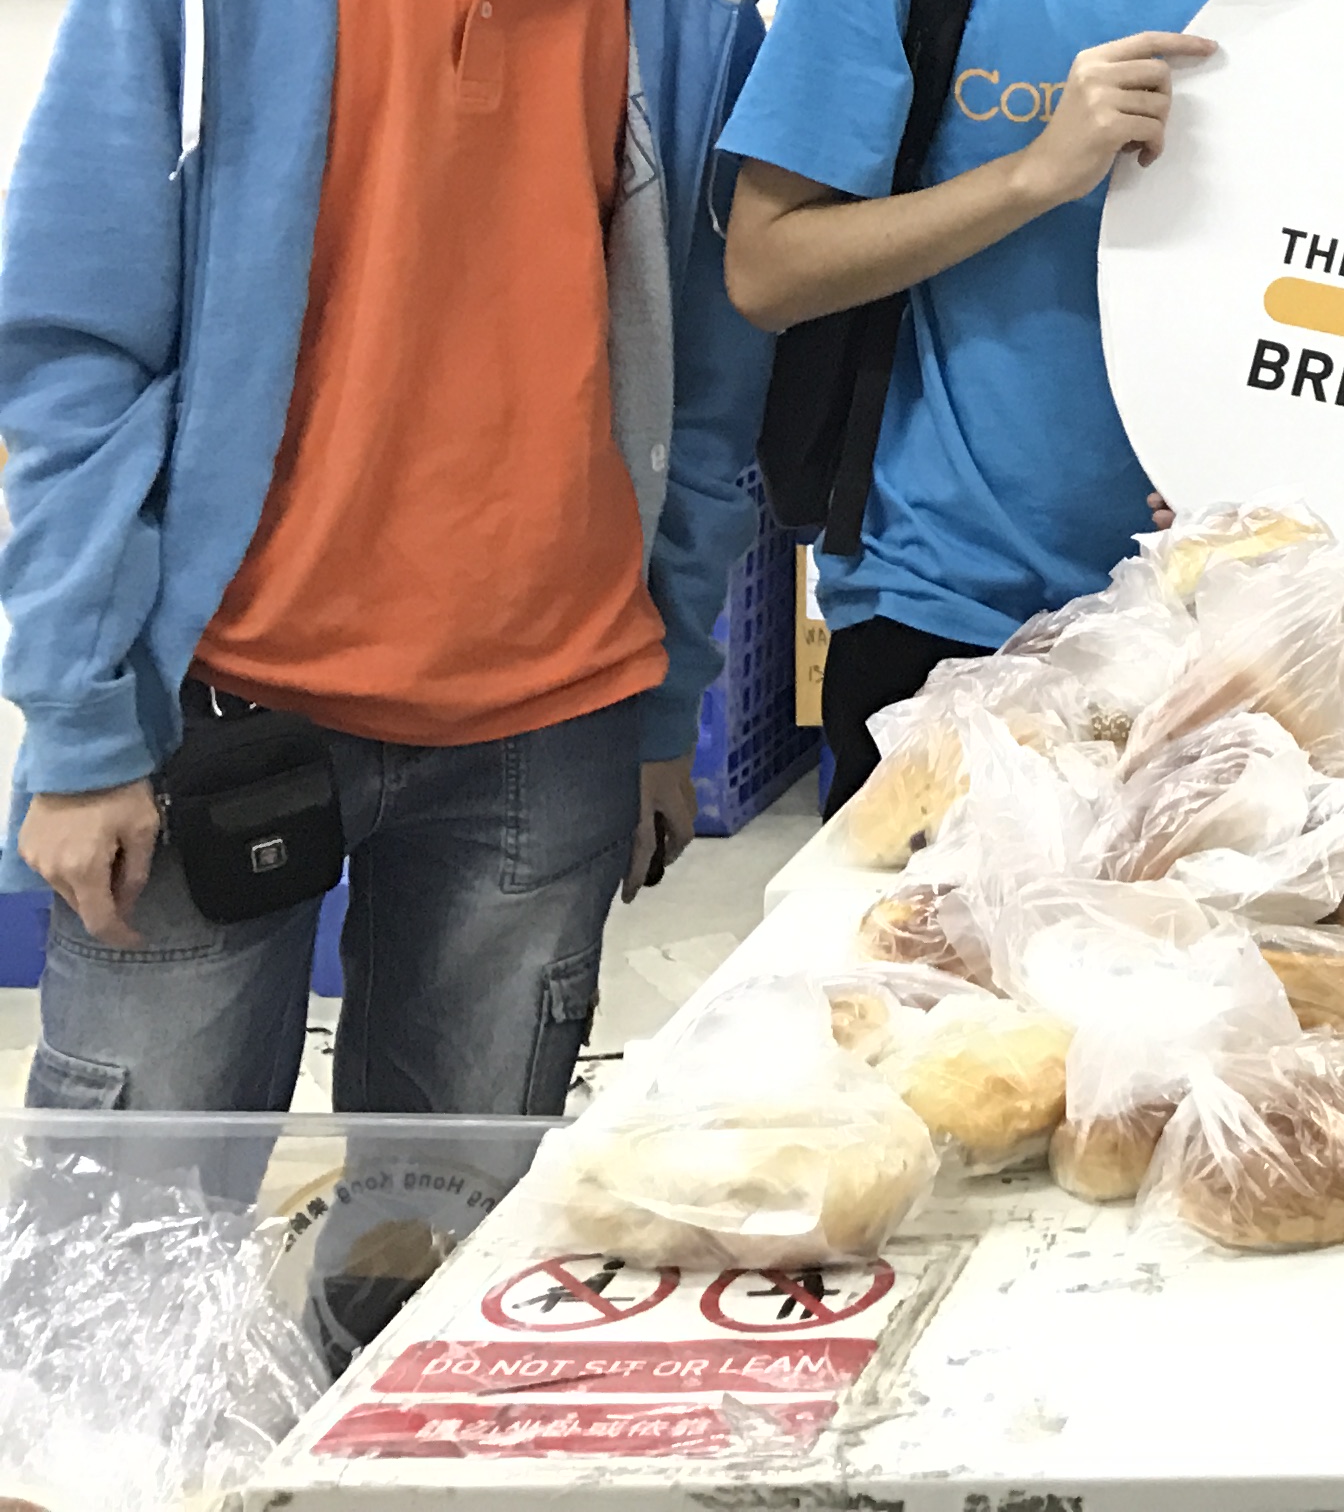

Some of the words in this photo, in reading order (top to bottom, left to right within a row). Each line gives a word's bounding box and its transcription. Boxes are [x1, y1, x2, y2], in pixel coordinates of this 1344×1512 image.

[422, 1358, 481, 1377] DO
[488, 1358, 576, 1378] NOT
[578, 1358, 647, 1378] SIT
[652, 1358, 710, 1378] OR
[718, 1355, 828, 1376] LEAN
